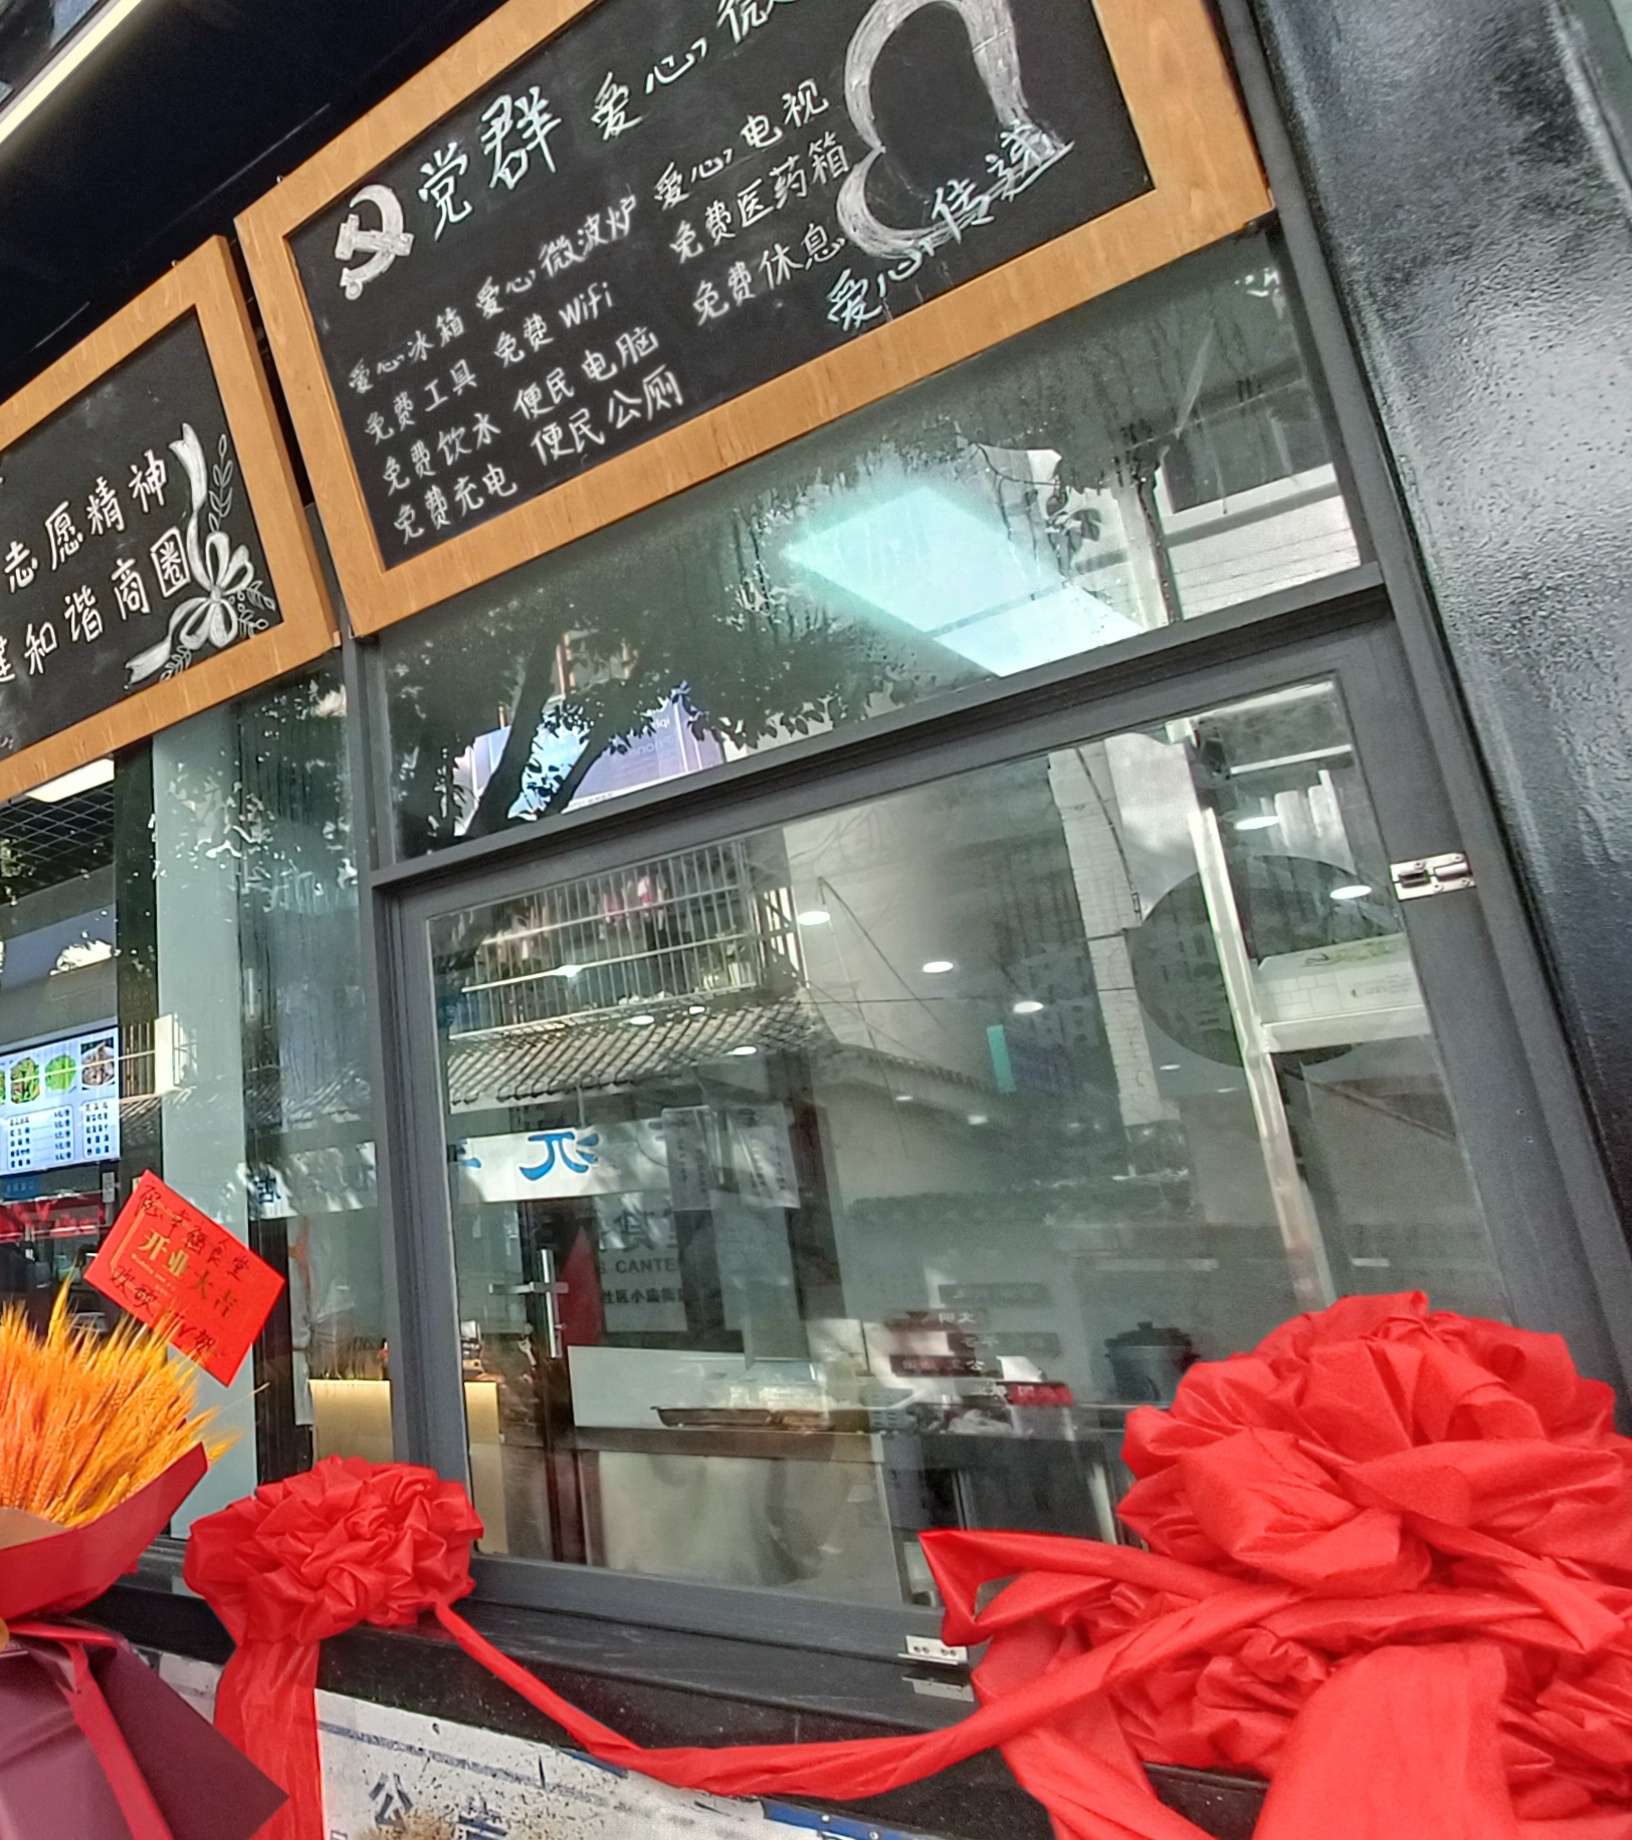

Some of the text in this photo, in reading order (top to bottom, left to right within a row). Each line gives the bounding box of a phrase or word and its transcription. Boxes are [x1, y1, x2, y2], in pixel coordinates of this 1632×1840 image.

[348, 78, 829, 394] 爱心冰箱 爱心微波炉 爱心电视
[364, 359, 477, 445] 免费工具
[670, 131, 849, 264] 免费医药箱
[382, 223, 845, 495] 免费饮水 便民电脑 免费休息
[394, 364, 684, 545] 免费充电 便民公厕
